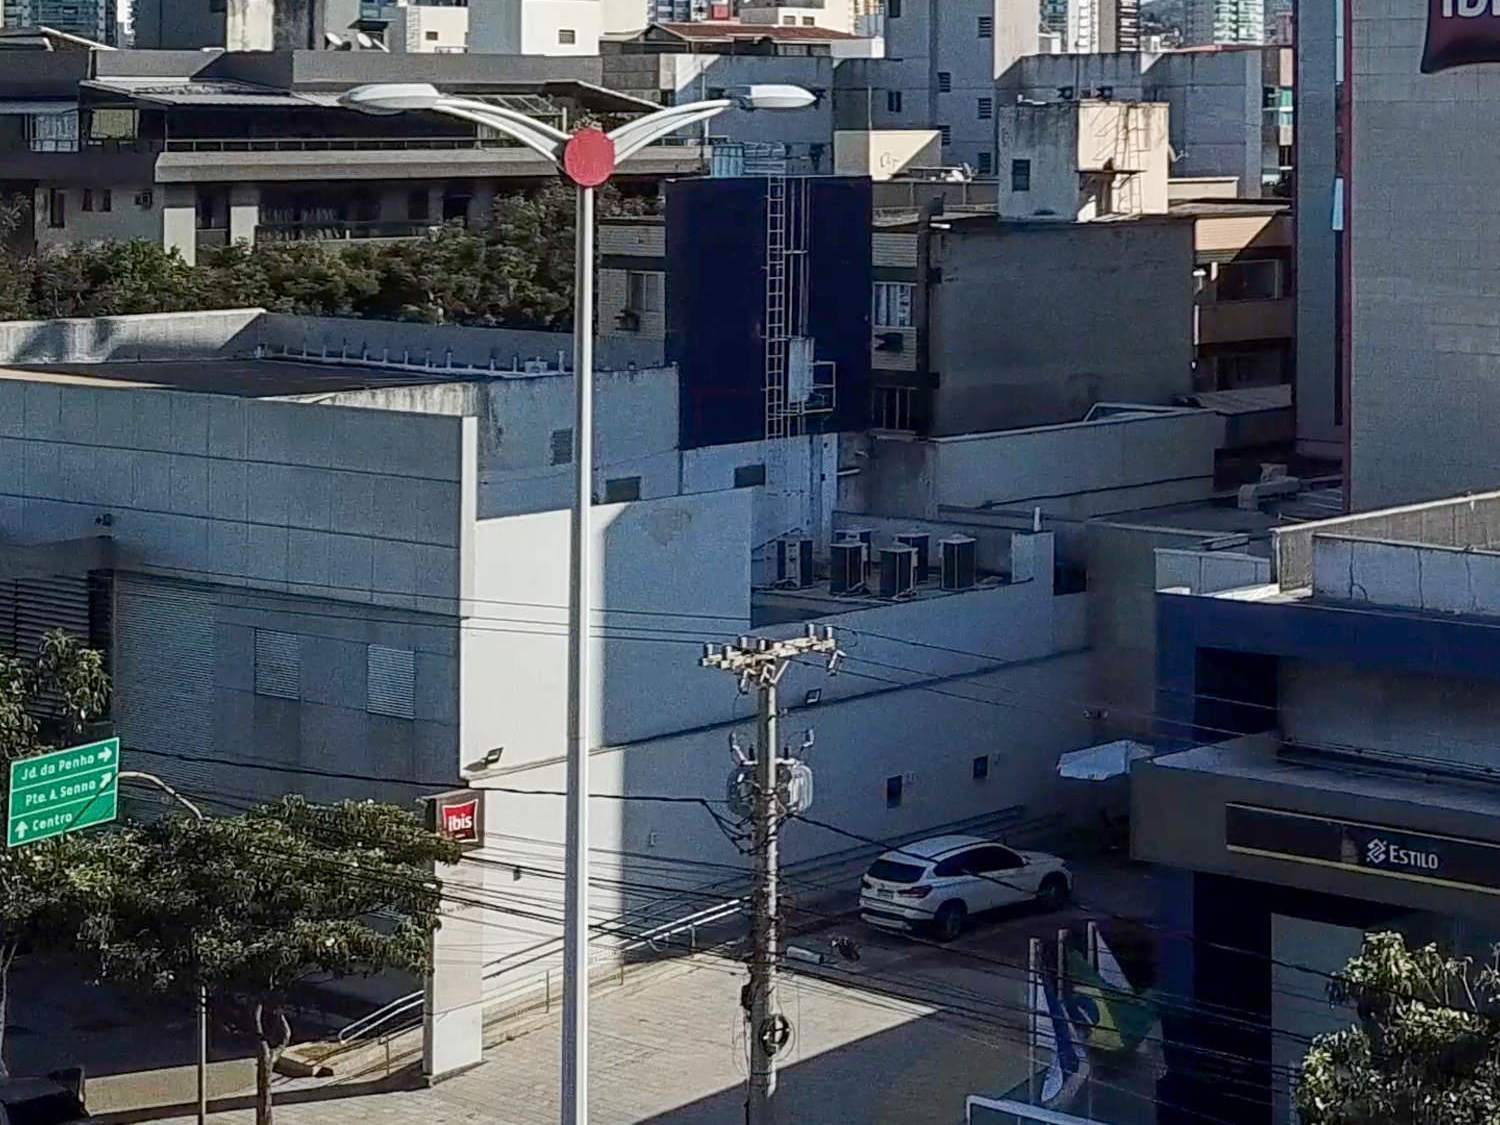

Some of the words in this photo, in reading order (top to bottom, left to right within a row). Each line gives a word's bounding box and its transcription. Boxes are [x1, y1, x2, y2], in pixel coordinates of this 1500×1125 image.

[40, 764, 56, 776] da
[58, 755, 95, 772] Penha
[60, 780, 96, 798] Senna
[32, 812, 73, 831] Centro
[448, 813, 473, 832] ibis
